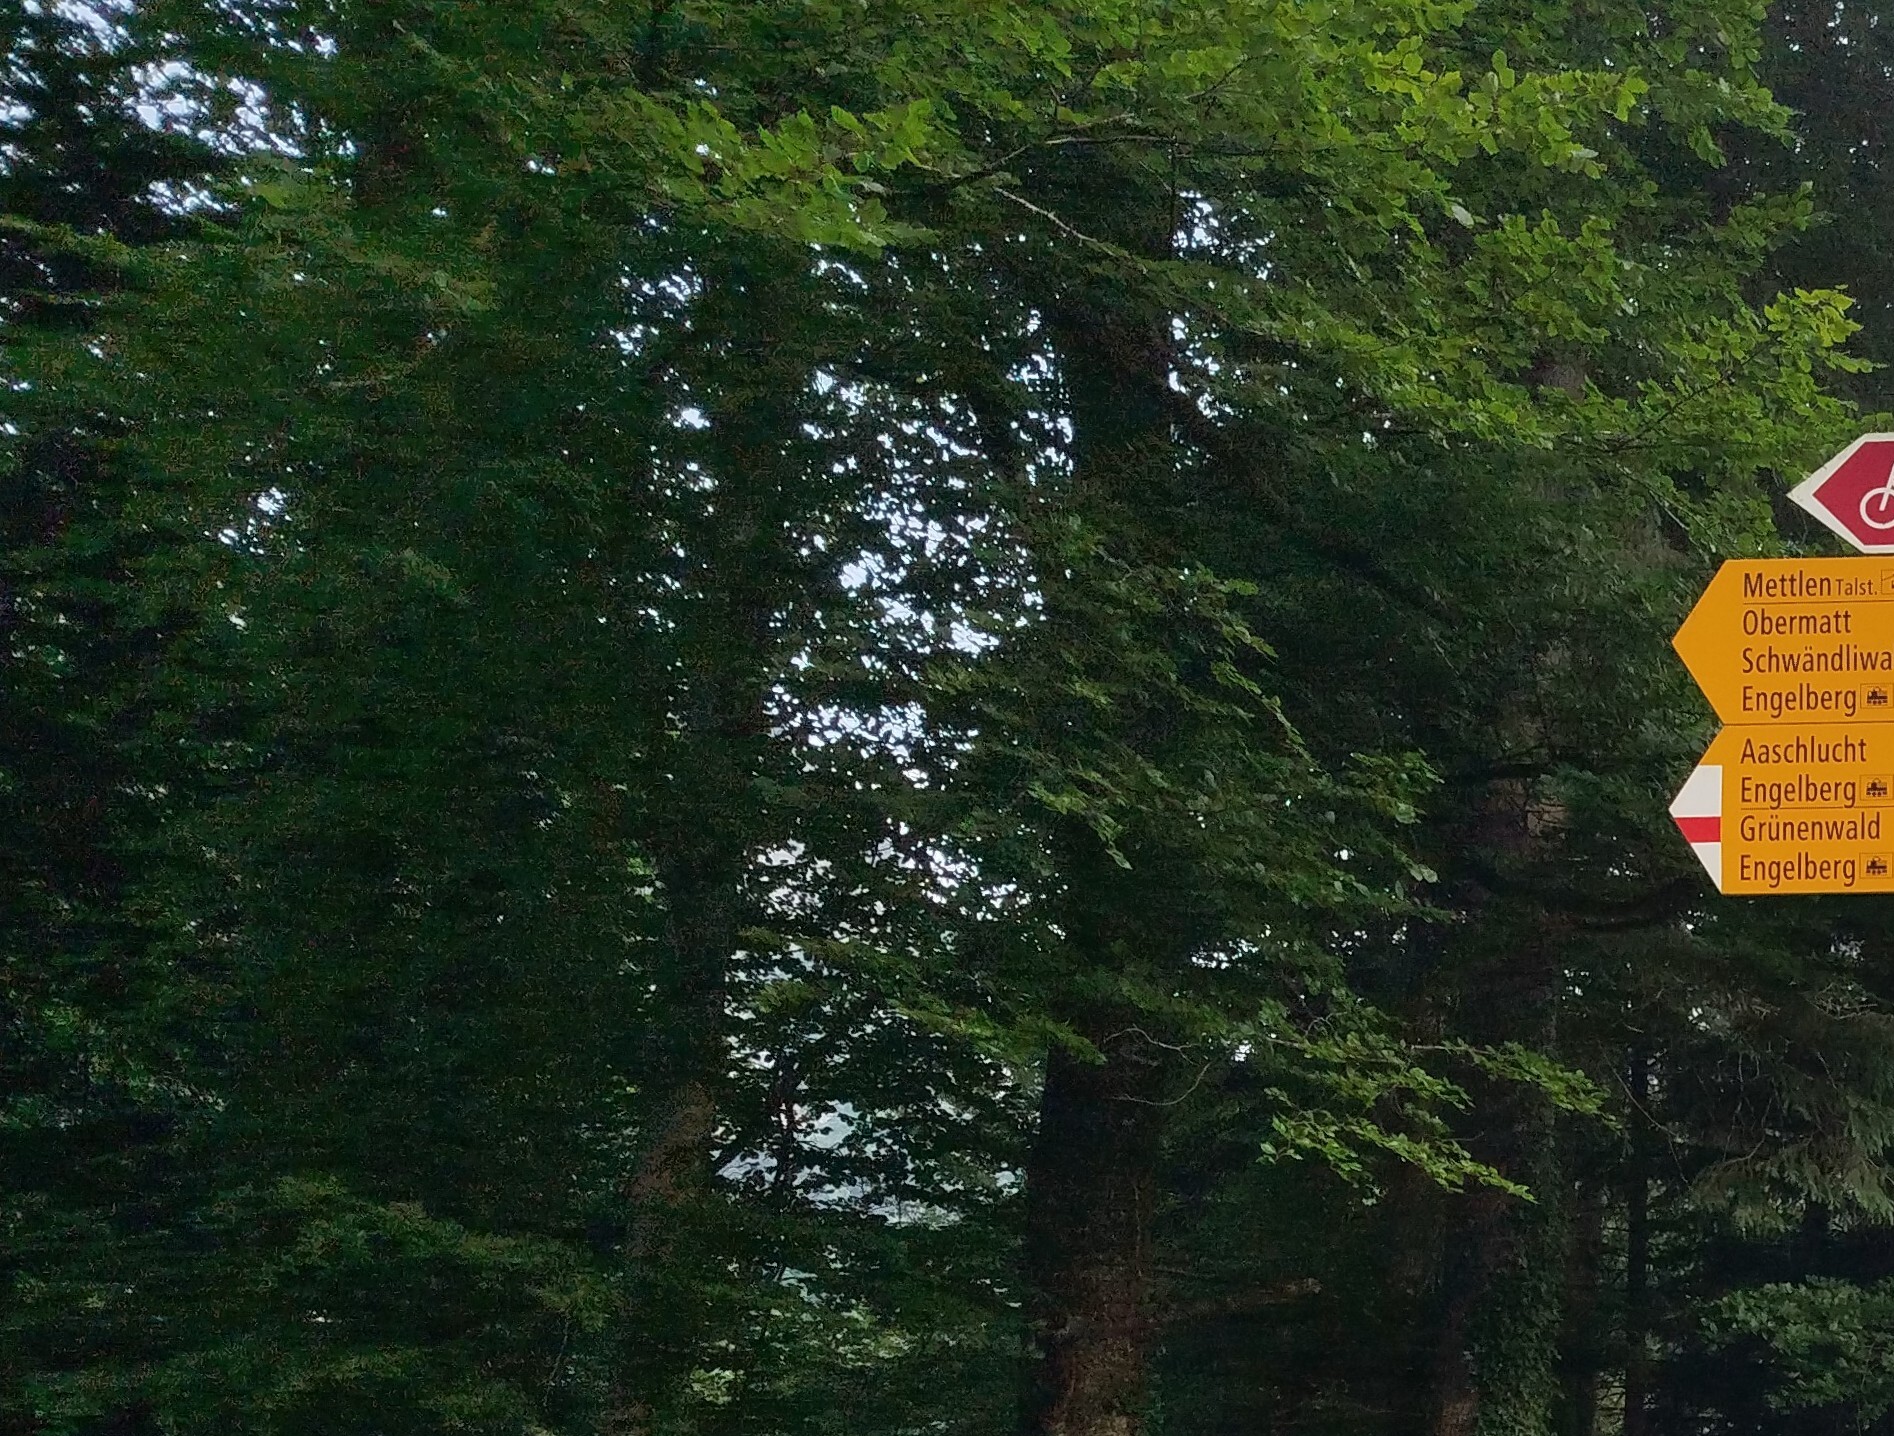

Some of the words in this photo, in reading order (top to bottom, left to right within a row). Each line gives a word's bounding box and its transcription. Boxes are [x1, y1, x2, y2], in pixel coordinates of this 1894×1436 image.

[1743, 570, 1832, 598] Mettlen
[1835, 577, 1878, 596] Talst.
[1742, 608, 1852, 636] Obermatt
[1742, 682, 1857, 719] Engelberg
[1740, 735, 1867, 765] Aaschlucht
[1741, 773, 1856, 810] Engelberg
[1740, 811, 1881, 842] Grünenwald
[1740, 851, 1856, 888] Engelberg
